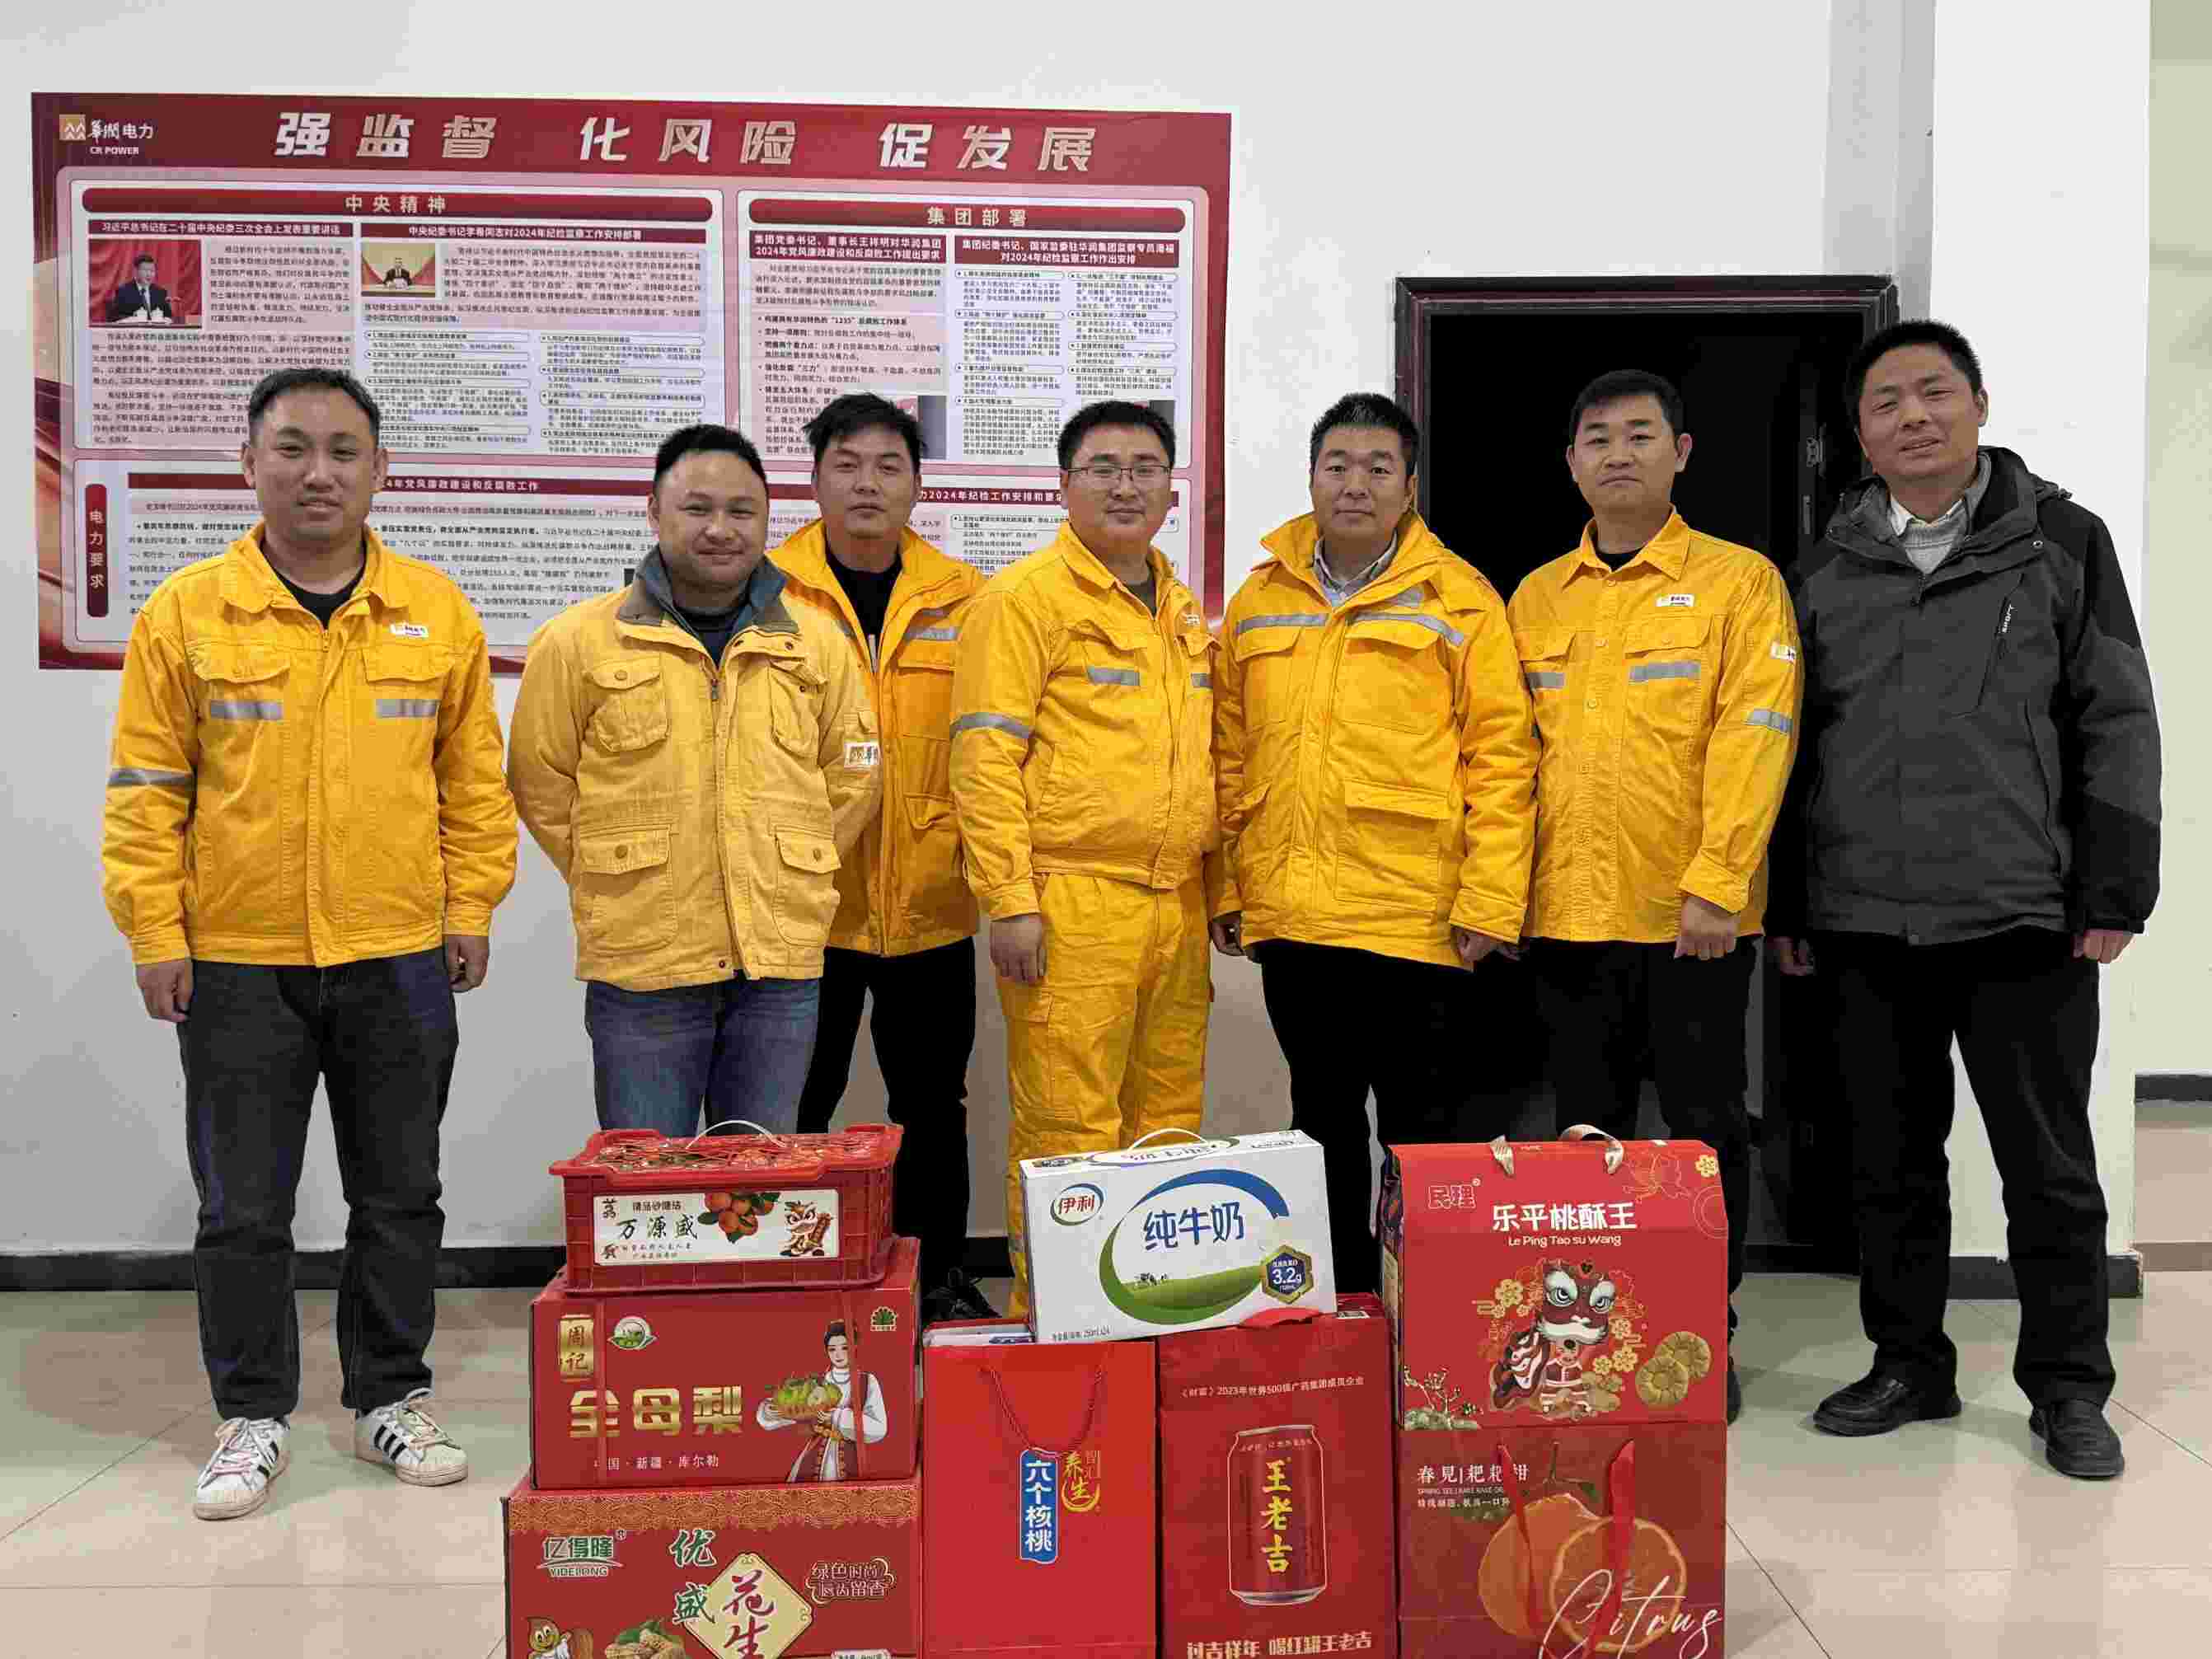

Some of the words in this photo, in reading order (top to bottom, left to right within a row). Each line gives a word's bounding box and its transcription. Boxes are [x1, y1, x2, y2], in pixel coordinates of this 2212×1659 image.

[274, 112, 496, 160] 强监督
[579, 117, 796, 164] 化风险
[879, 123, 1097, 172] 促发展
[345, 194, 447, 213] 中央精神
[927, 206, 1026, 227] 集团部署
[89, 510, 105, 588] 电力要求
[1057, 1195, 1095, 1215] 伊利
[1144, 1201, 1244, 1250] 纯牛奶
[1493, 1202, 1638, 1232] 乐平桃酥王
[1508, 1235, 1521, 1246] Le
[1522, 1235, 1548, 1248] Ping
[1549, 1235, 1571, 1245] Tao
[1573, 1236, 1586, 1245] su
[1588, 1235, 1621, 1248] Wang
[1272, 1267, 1301, 1284] 3.2g
[569, 1385, 743, 1438] 全母梨
[1024, 1460, 1052, 1553] 六个核桃
[1261, 1459, 1293, 1573] 王老吉
[542, 1536, 614, 1559] 亿得隆
[722, 1570, 775, 1659] 花生
[1538, 1569, 1722, 1659] Citrus
